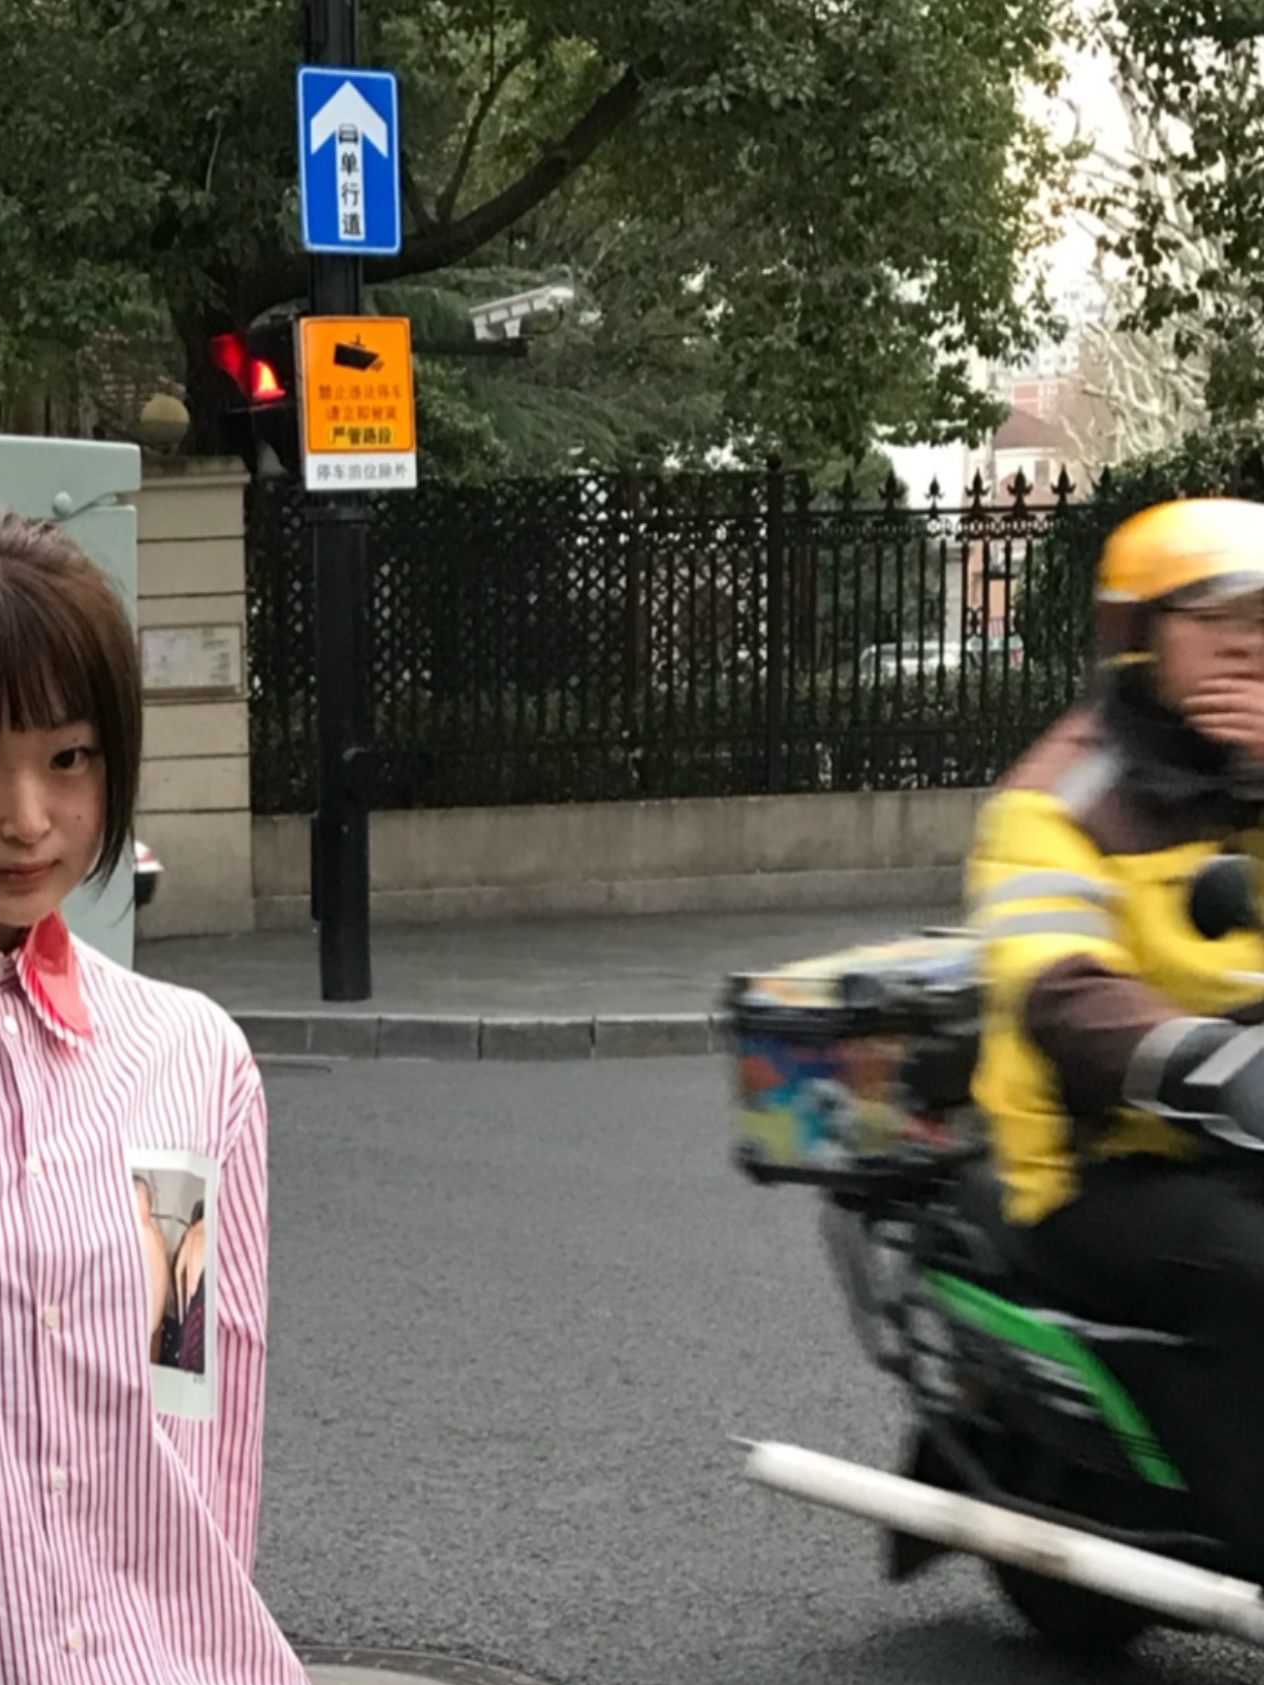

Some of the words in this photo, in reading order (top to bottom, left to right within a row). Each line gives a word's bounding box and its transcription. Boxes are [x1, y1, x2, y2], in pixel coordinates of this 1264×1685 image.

[340, 152, 361, 236] 单行道
[332, 426, 392, 445] 严管路段
[316, 462, 407, 481] 停车泊位除外
